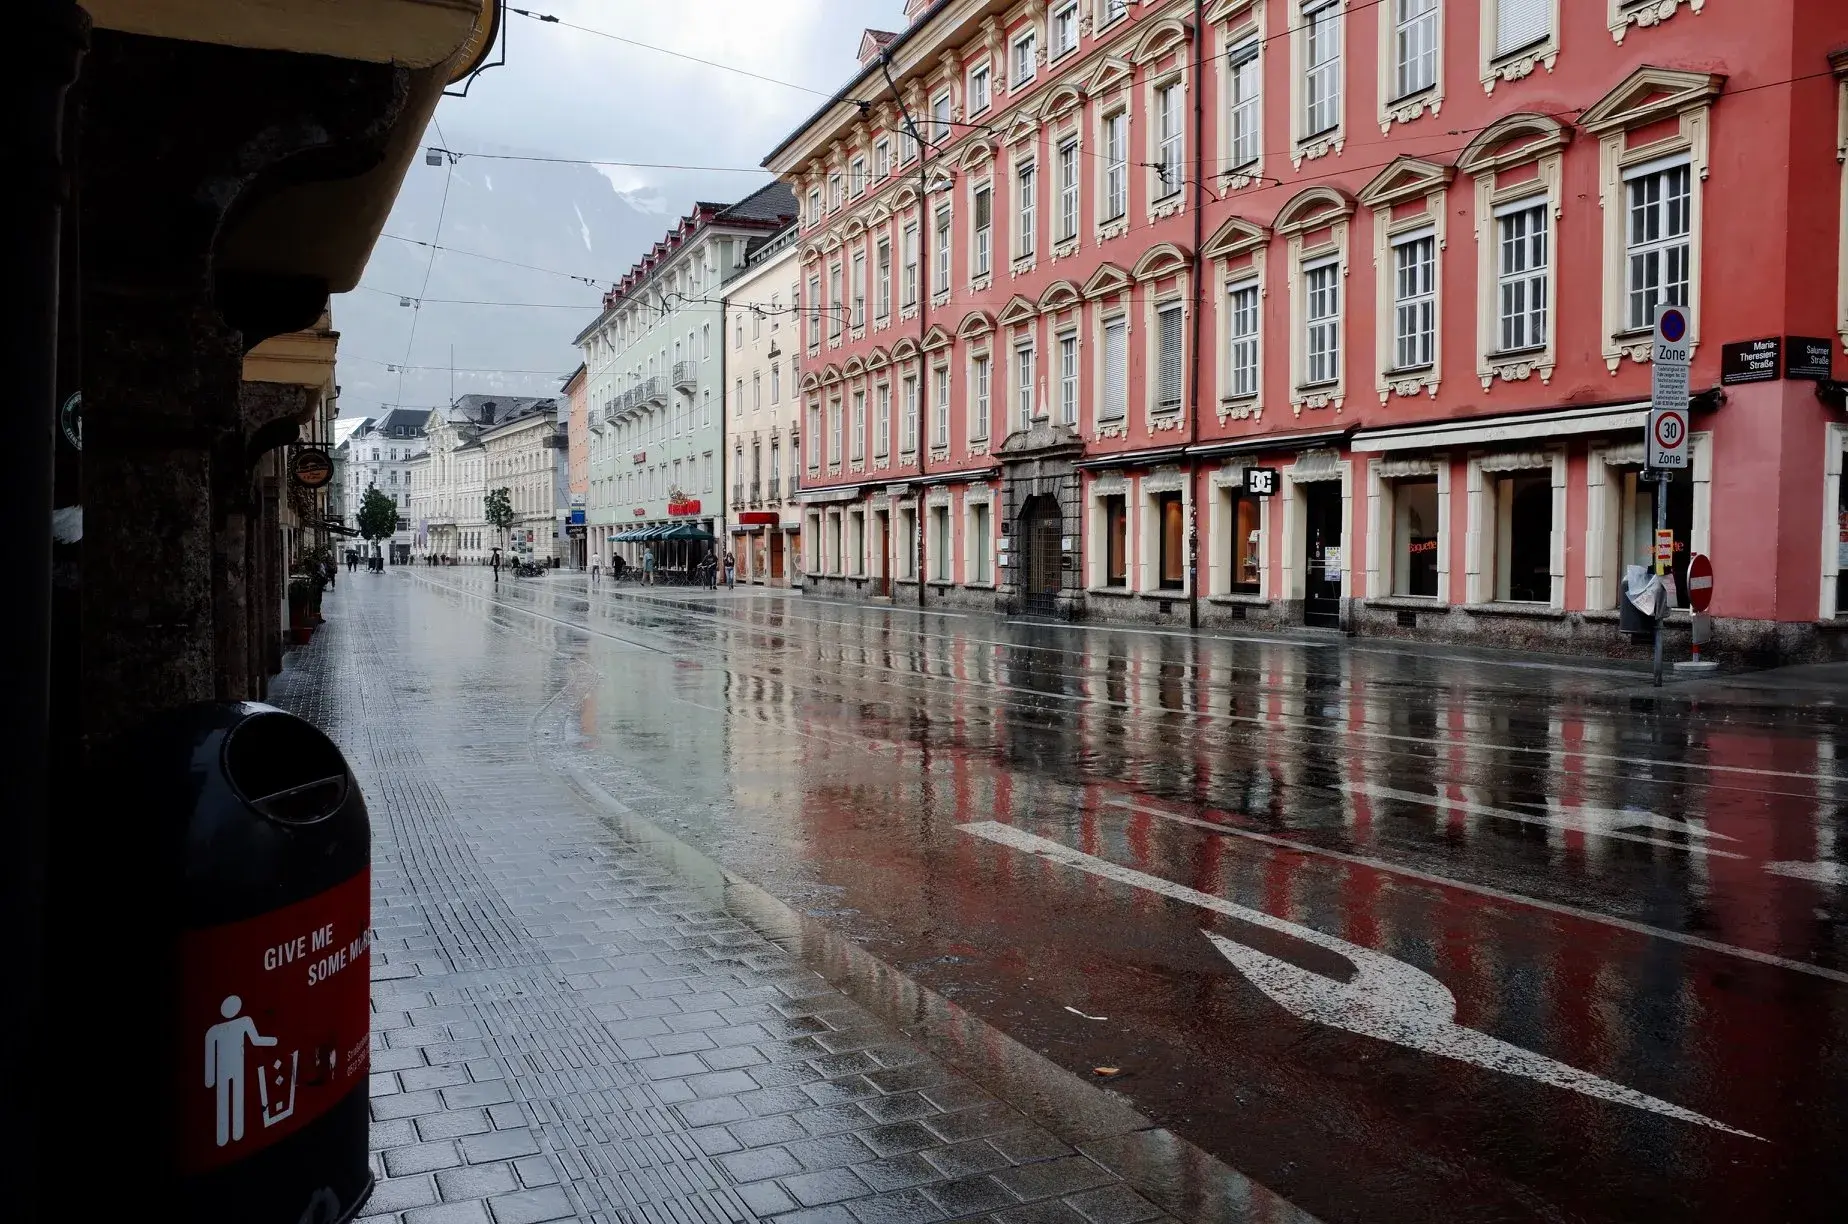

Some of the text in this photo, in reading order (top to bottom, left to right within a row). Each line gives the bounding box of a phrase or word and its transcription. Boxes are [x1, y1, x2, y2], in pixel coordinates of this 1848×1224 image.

[1753, 341, 1777, 351] Maria-
[1806, 345, 1829, 355] Salurner
[1659, 345, 1686, 361] Zone
[1740, 350, 1777, 362] Theresien-
[1749, 360, 1774, 370] Straße
[1810, 355, 1829, 365] Straße
[1663, 422, 1677, 439] 30
[1658, 452, 1681, 465] Zone
[1250, 471, 1272, 493] DC
[264, 923, 333, 971] GIVE ME
[308, 947, 347, 987] SOME
